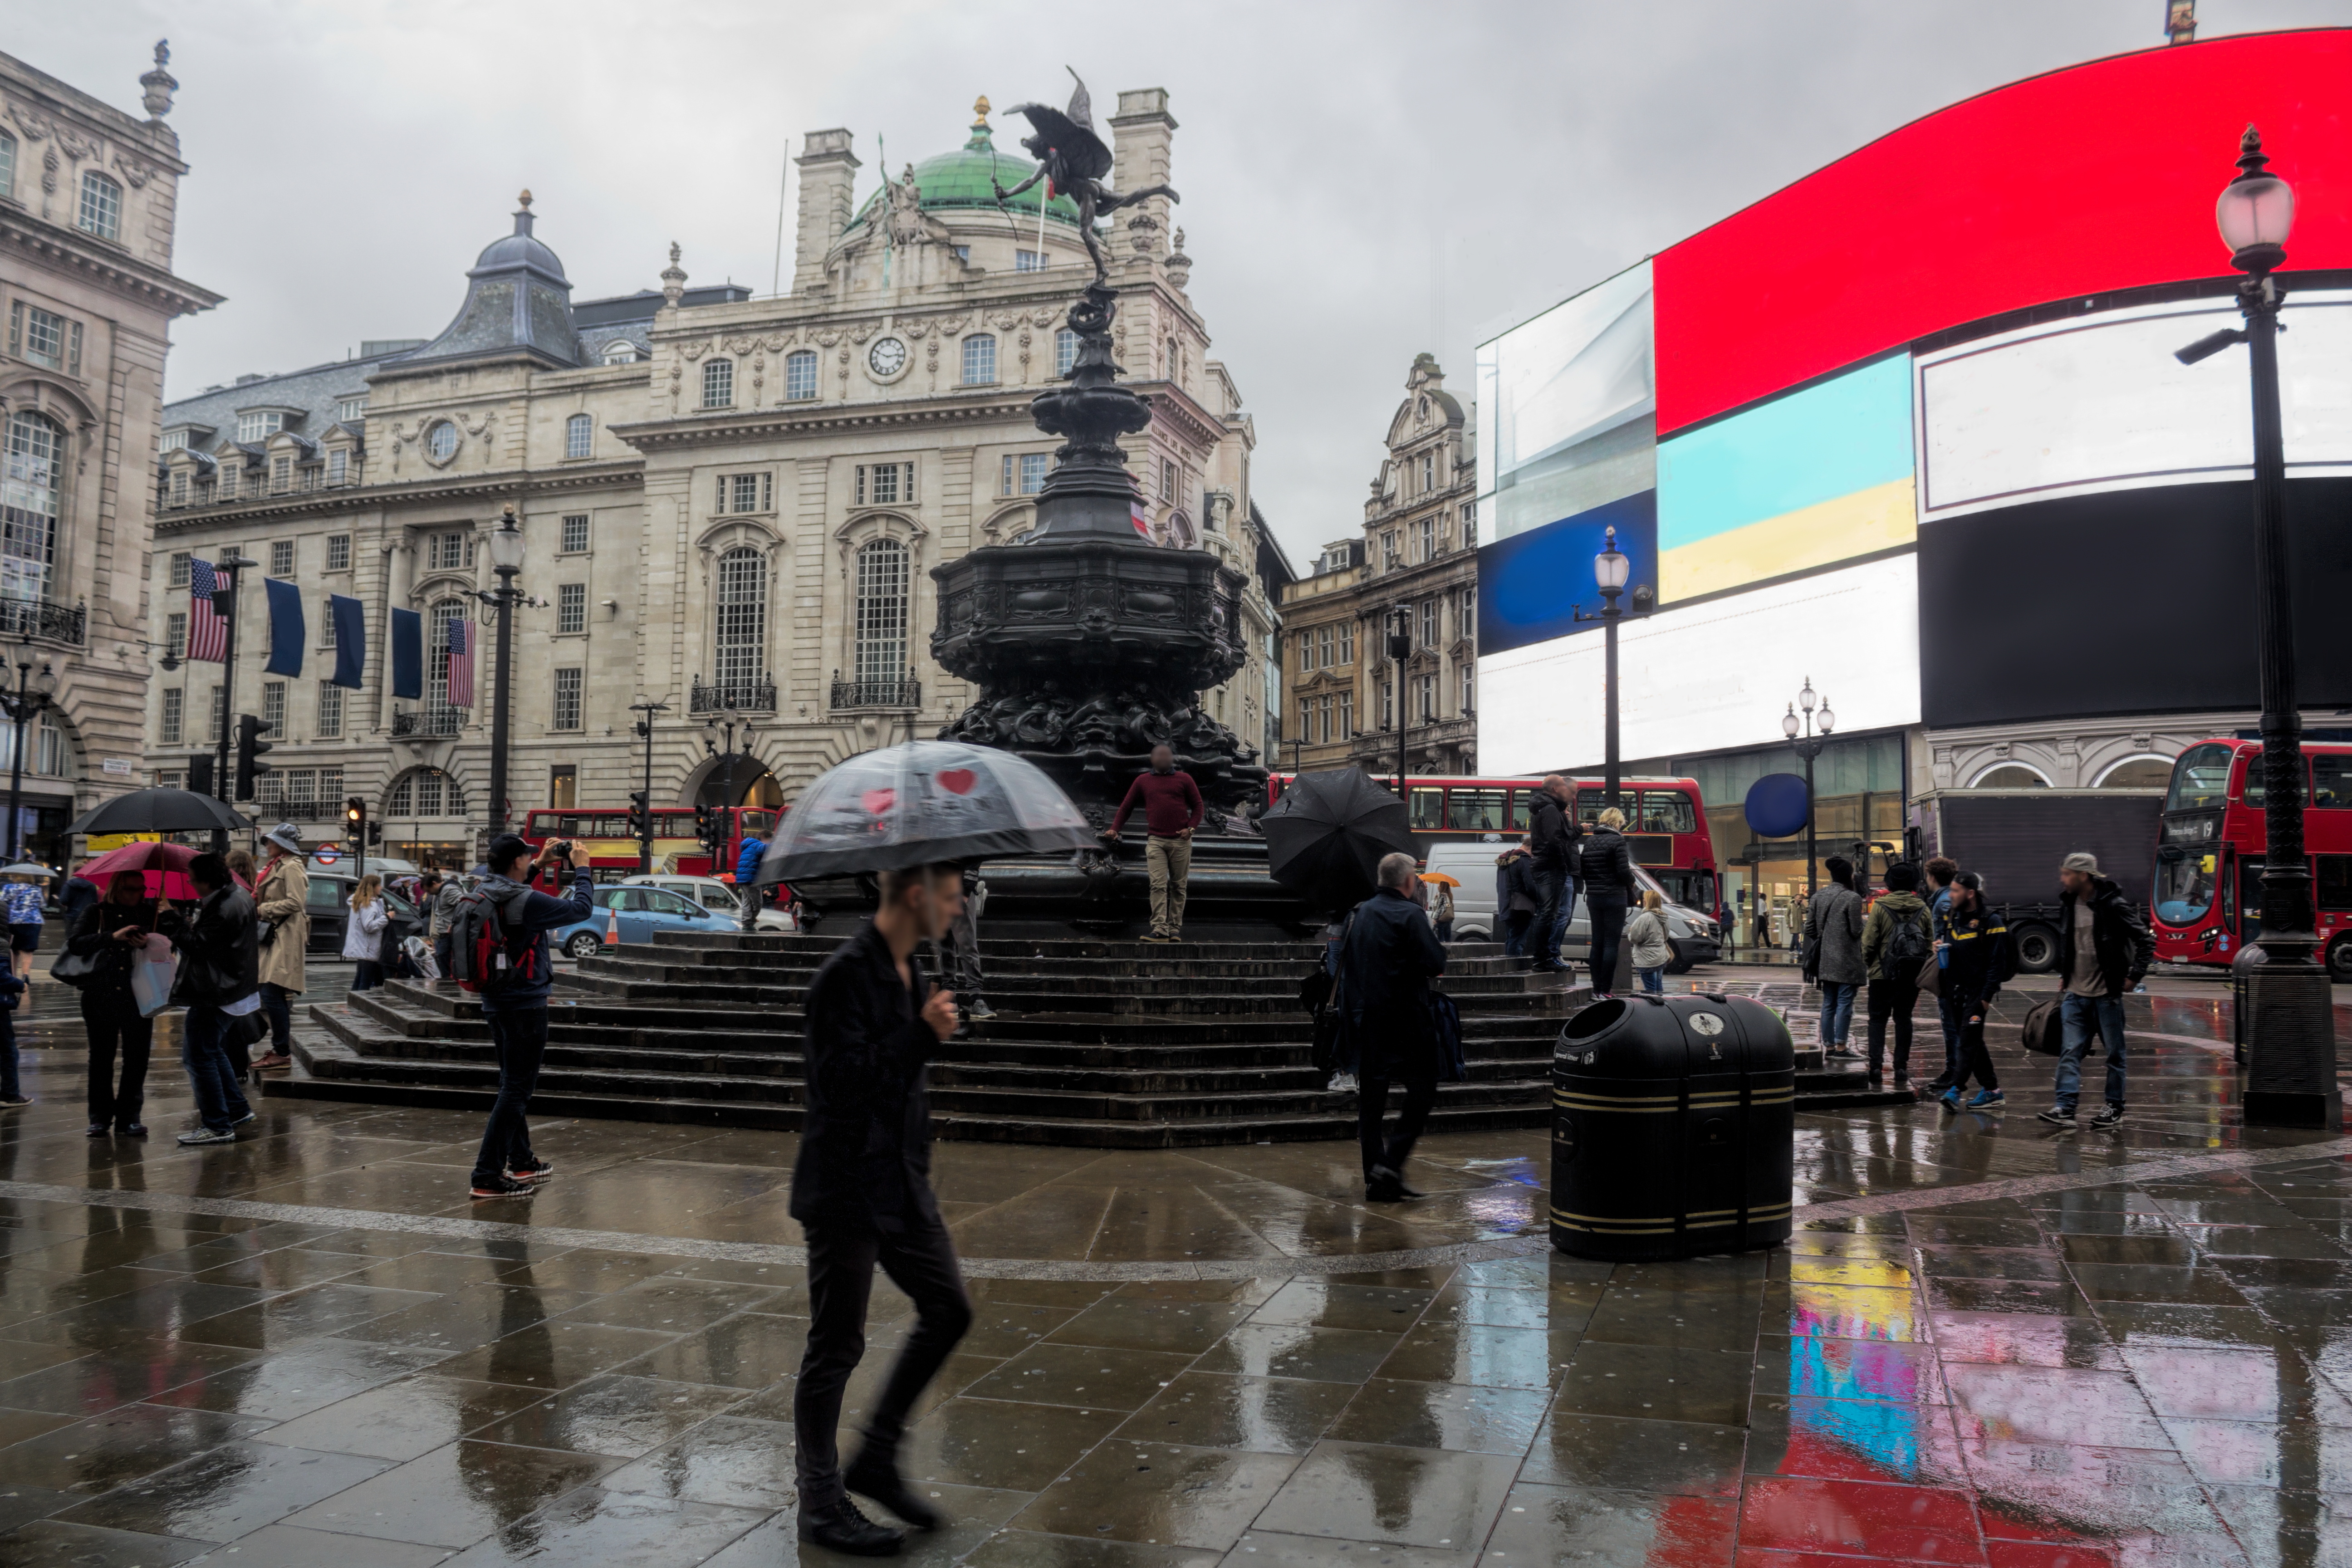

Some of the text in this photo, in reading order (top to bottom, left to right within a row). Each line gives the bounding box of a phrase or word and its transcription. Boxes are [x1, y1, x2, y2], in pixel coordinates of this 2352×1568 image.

[1151, 424, 1168, 443] ALLIANCE
[1180, 446, 1191, 461] OFFICE
[2203, 821, 2213, 837] 19
